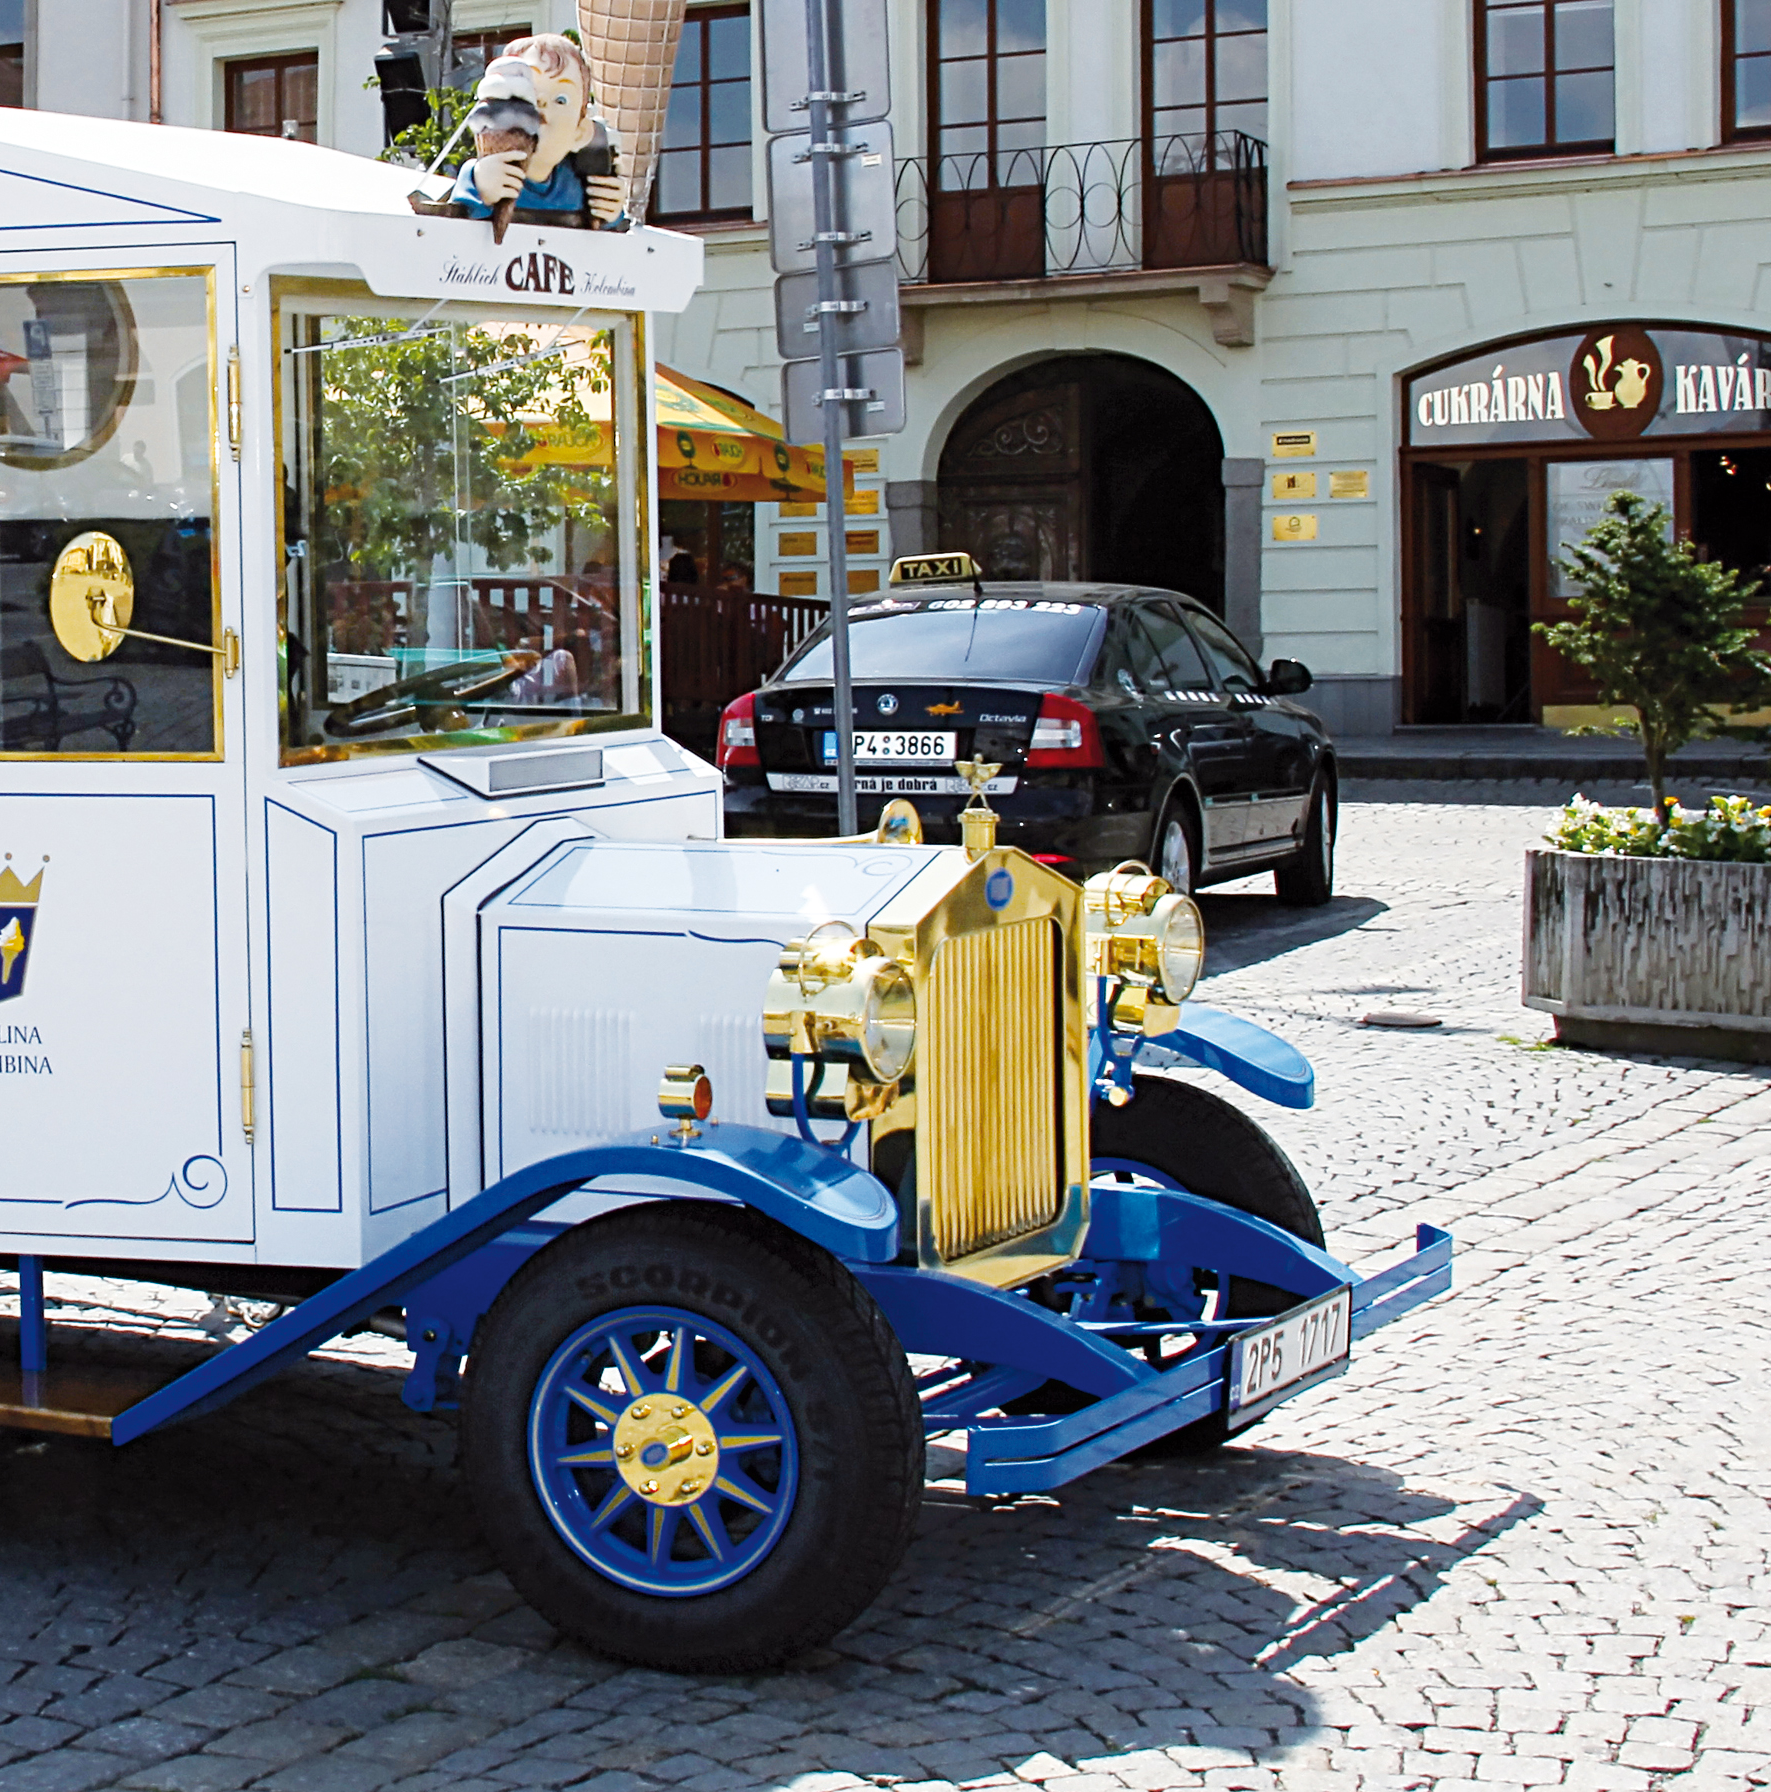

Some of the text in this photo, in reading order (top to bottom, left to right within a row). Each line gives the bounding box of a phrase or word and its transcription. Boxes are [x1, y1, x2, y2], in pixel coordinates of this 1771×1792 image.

[505, 252, 576, 295] CAFE
[1418, 364, 1565, 427] CUKRÁRNA
[902, 558, 961, 579] TAXI
[1030, 600, 1081, 616] 223
[979, 712, 1027, 724] Octavia
[852, 734, 946, 757] P4 3866
[880, 777, 894, 793] je
[897, 776, 938, 792] dobrá
[1244, 1301, 1342, 1396] 2P5 1717
